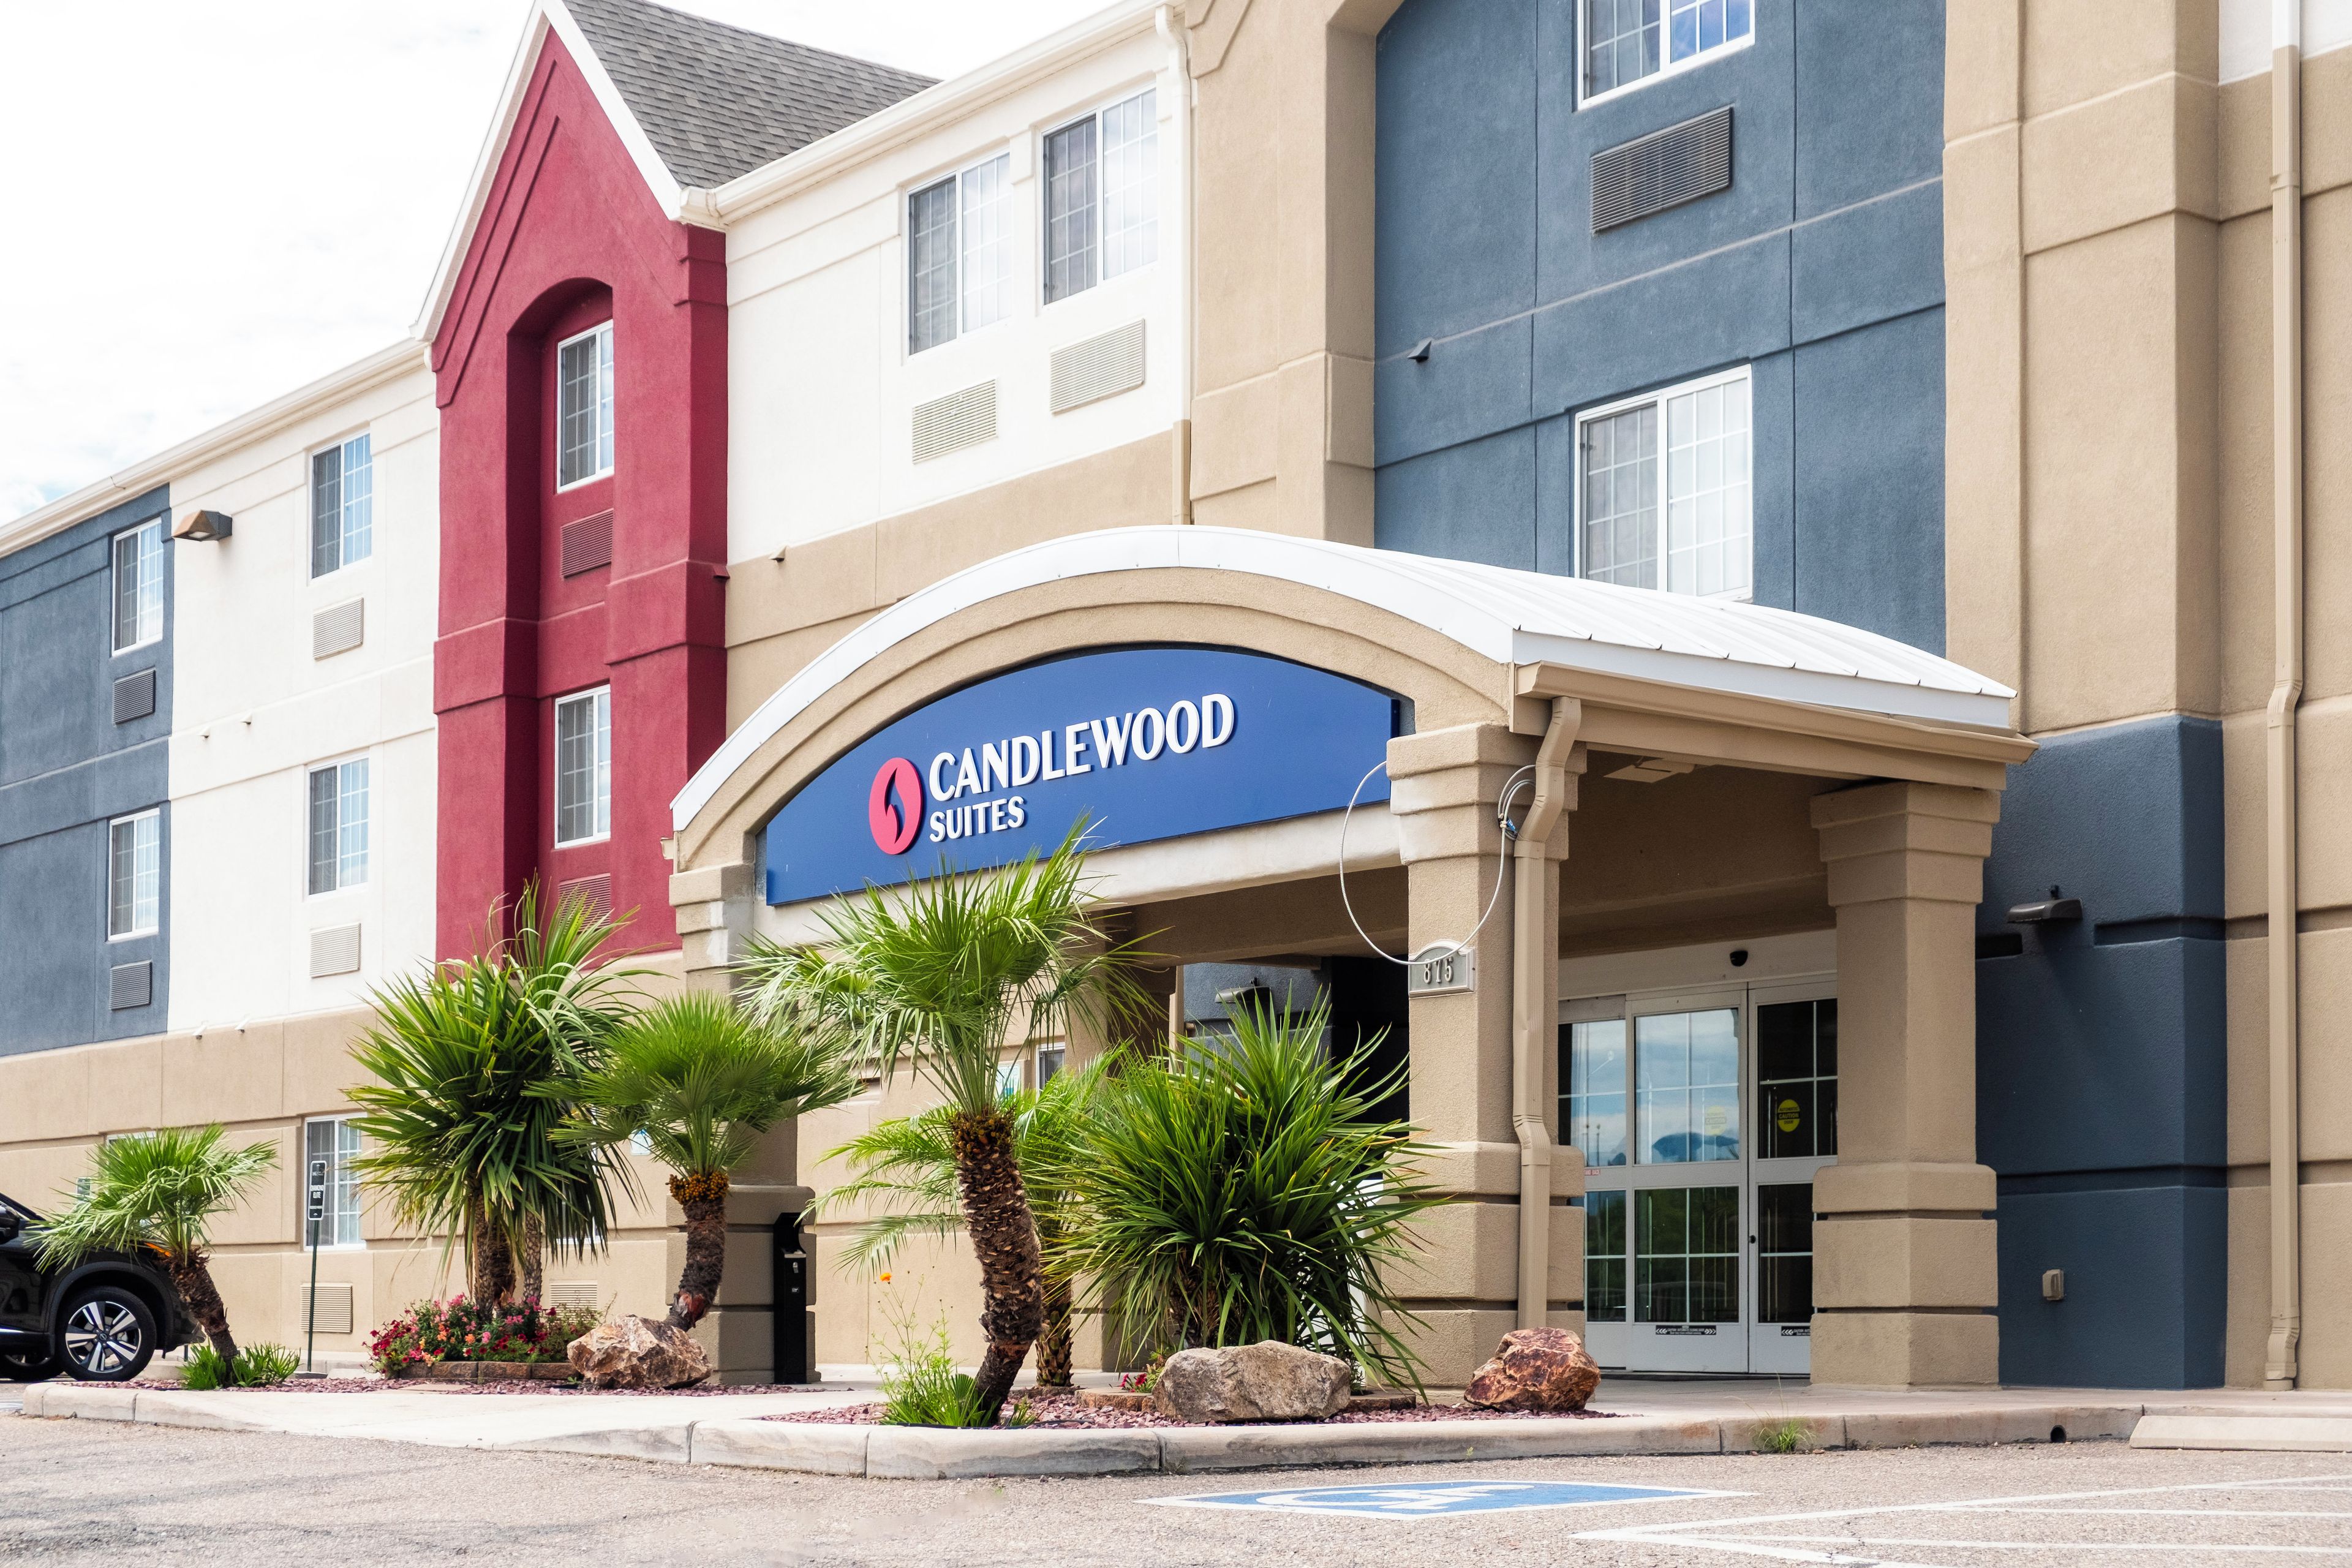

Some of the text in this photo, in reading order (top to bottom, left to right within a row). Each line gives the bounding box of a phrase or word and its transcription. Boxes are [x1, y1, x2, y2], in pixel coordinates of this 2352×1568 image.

[929, 693, 1236, 802] CANDLEWOOD
[929, 796, 1026, 842] SUITES
[1423, 956, 1454, 984] 875
